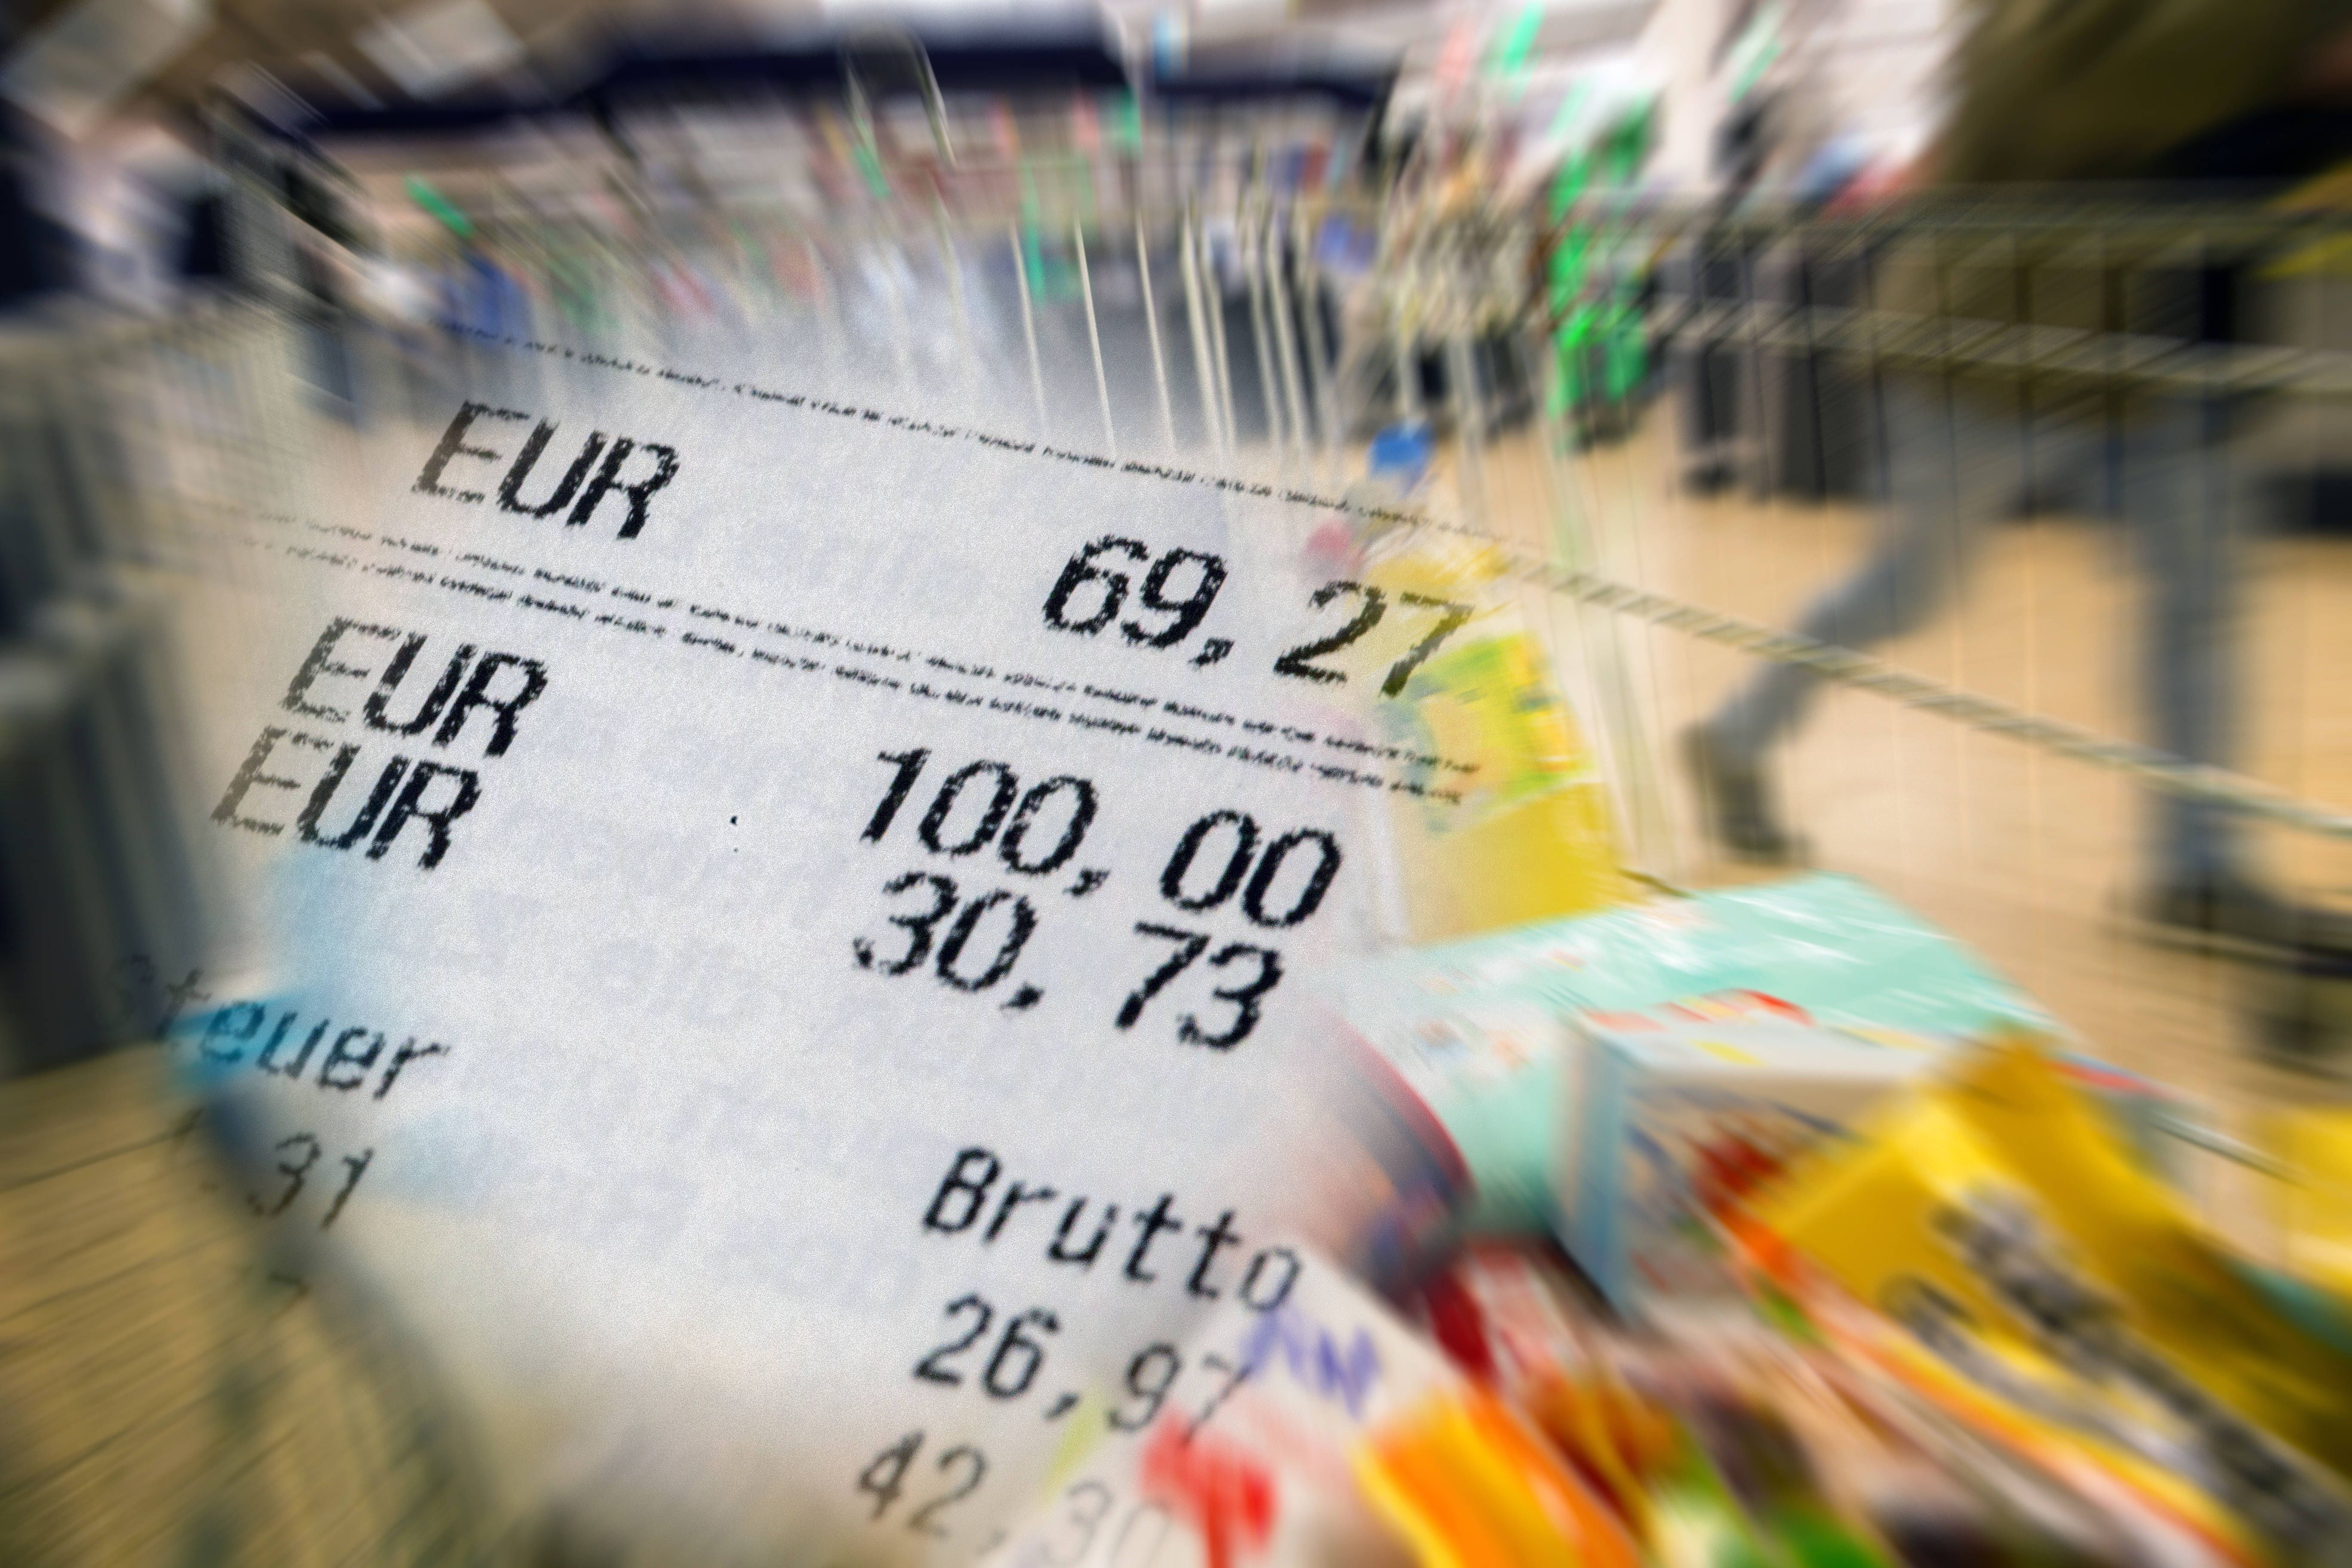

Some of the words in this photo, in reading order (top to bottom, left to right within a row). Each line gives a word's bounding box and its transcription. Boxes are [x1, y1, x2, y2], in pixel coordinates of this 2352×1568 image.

[413, 398, 680, 539] EUR
[1042, 535, 1470, 698] 69,27
[213, 728, 481, 871] EUR
[854, 872, 1283, 1053] 30,73
[283, 617, 548, 757] EUR
[861, 747, 1342, 928] 100,00
[912, 1293, 1253, 1451] 26,97
[921, 1146, 1301, 1314] Brutto
